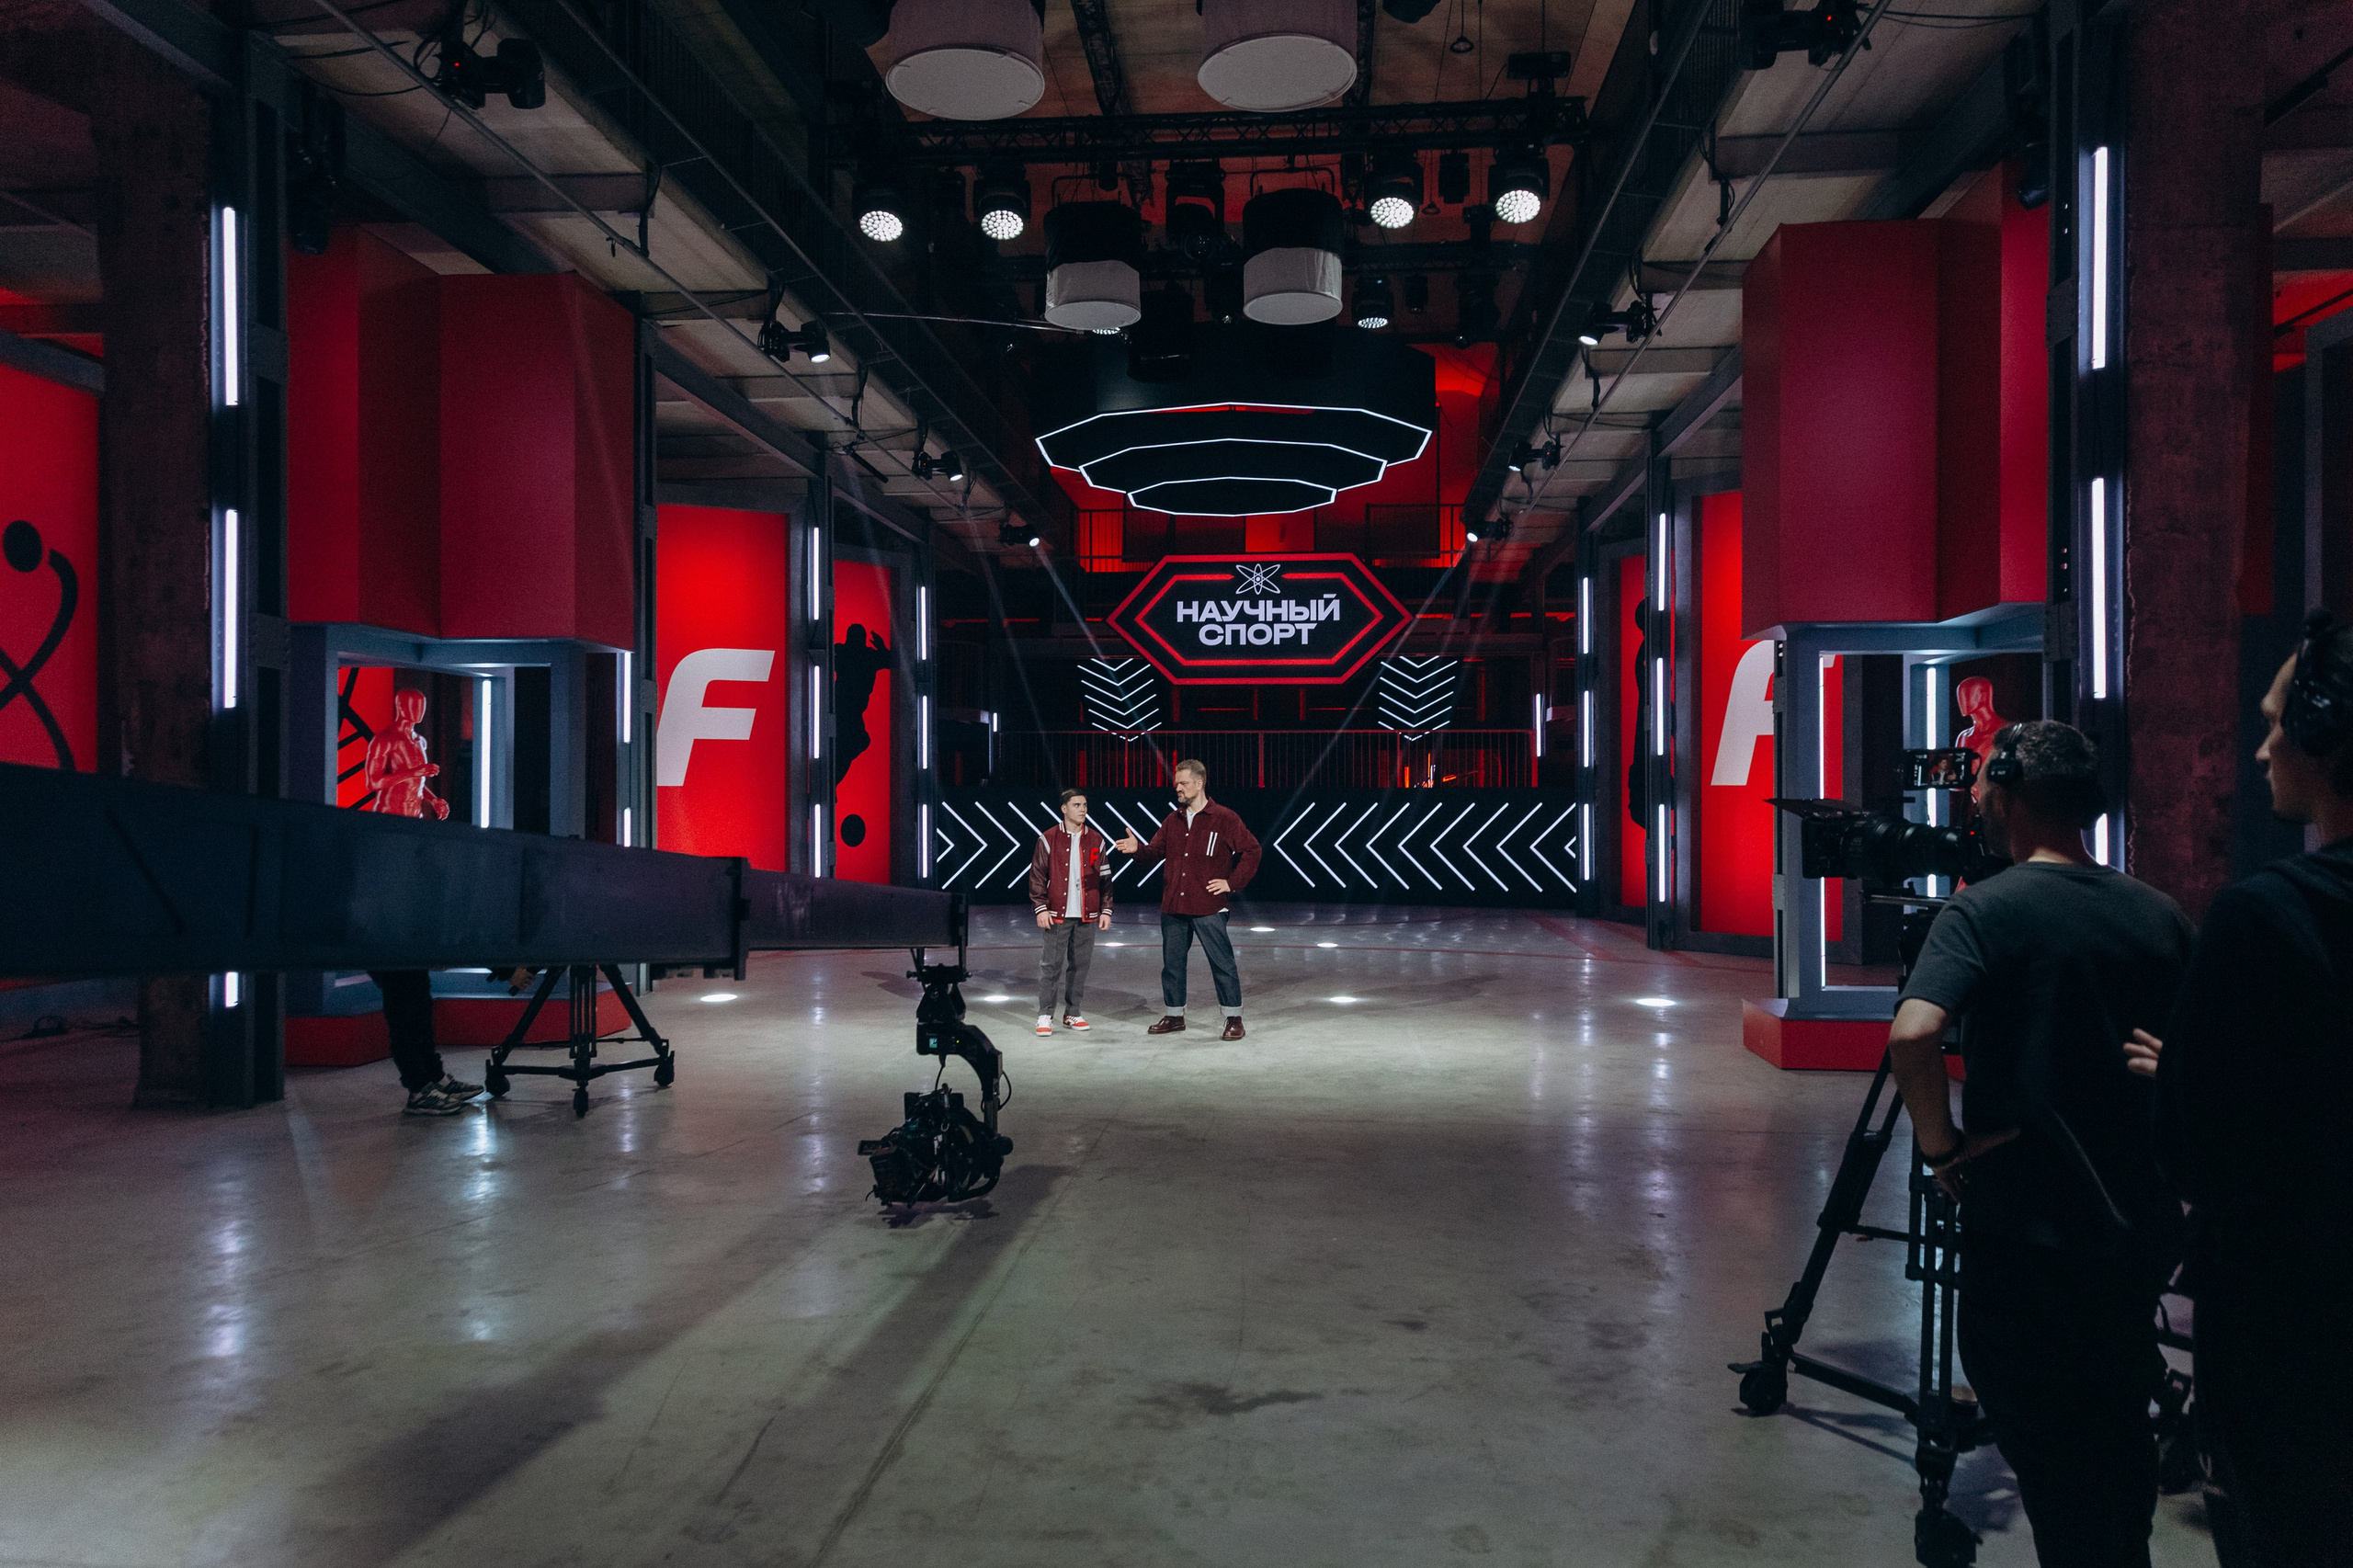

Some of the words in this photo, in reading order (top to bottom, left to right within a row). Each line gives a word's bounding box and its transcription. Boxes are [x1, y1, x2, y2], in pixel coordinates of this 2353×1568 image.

[1176, 594, 1340, 622] НАУЧНЫЙ
[1199, 622, 1317, 645] СПОРТ
[656, 648, 776, 787] F
[1089, 847, 1100, 866] F
